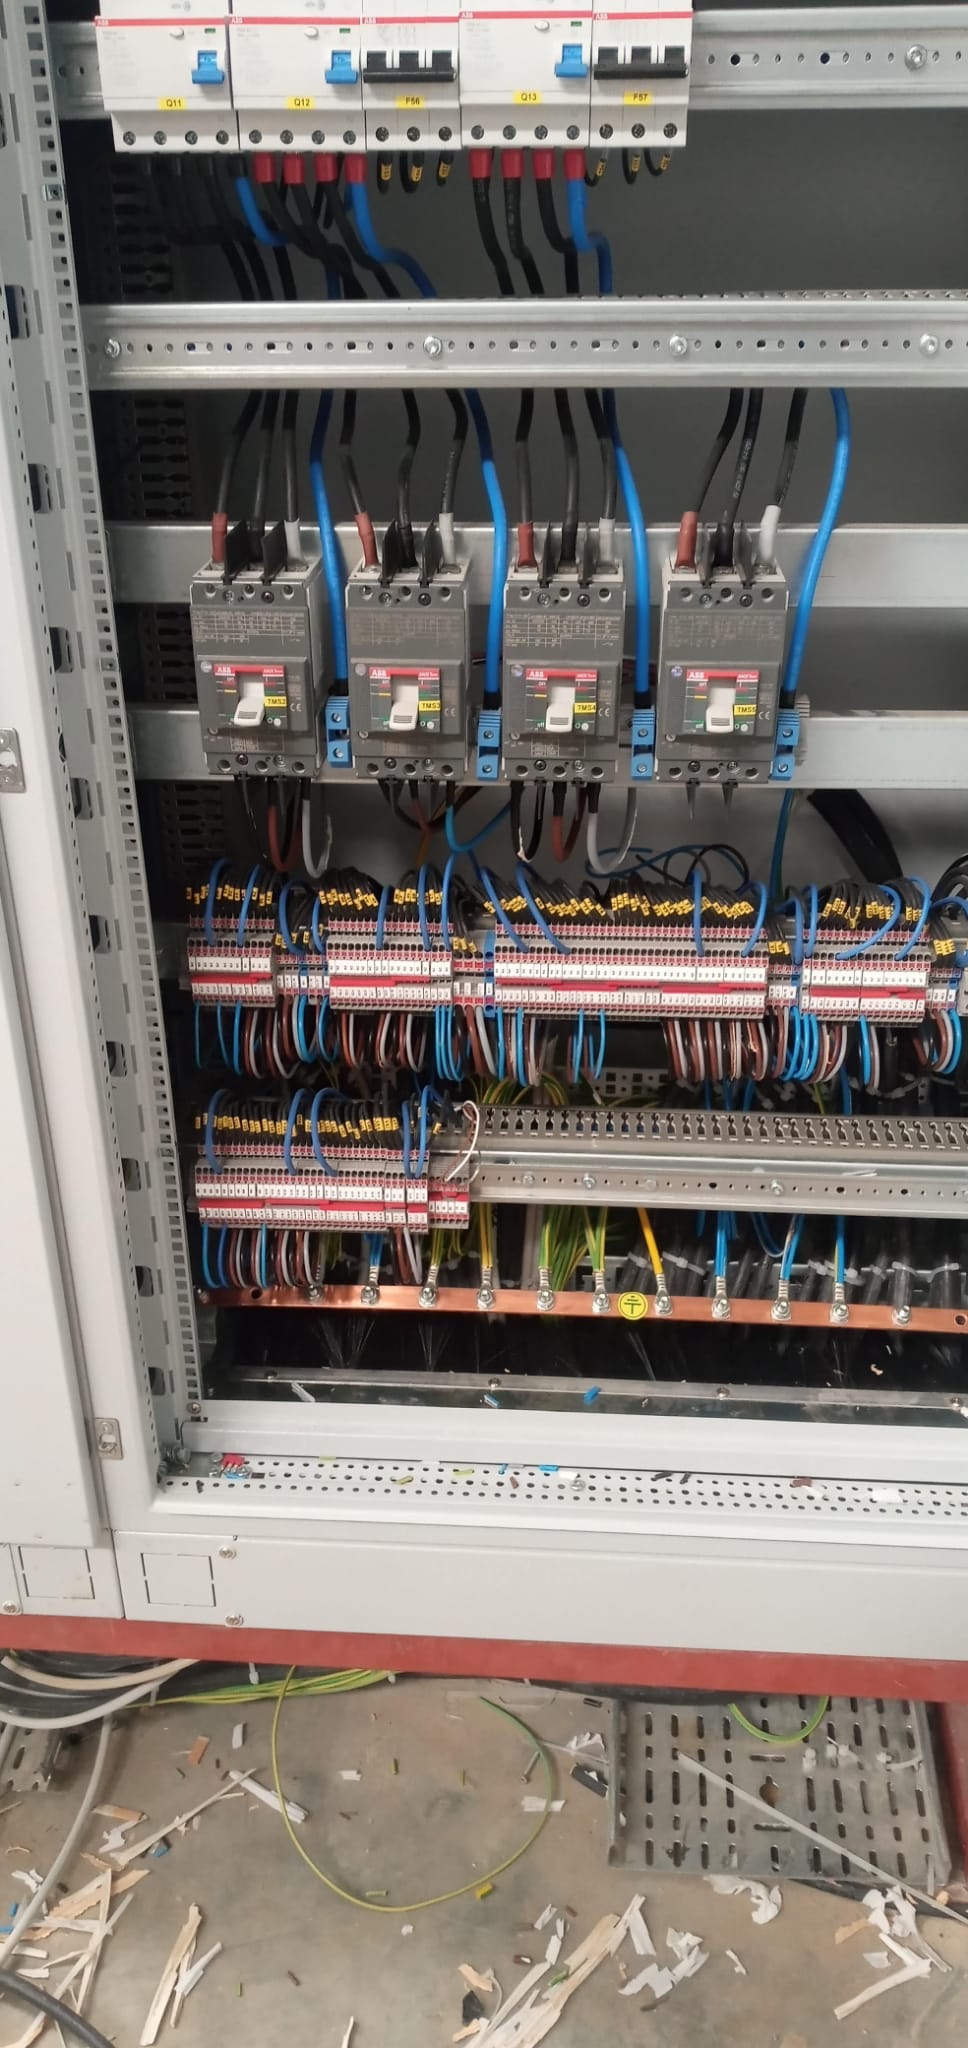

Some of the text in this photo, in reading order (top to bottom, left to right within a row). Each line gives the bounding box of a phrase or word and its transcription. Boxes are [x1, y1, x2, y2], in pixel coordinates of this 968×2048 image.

[405, 96, 420, 105] F56
[521, 93, 537, 102] Q13
[633, 93, 648, 101] F57
[166, 99, 182, 107] Q11
[294, 98, 310, 107] Q12
